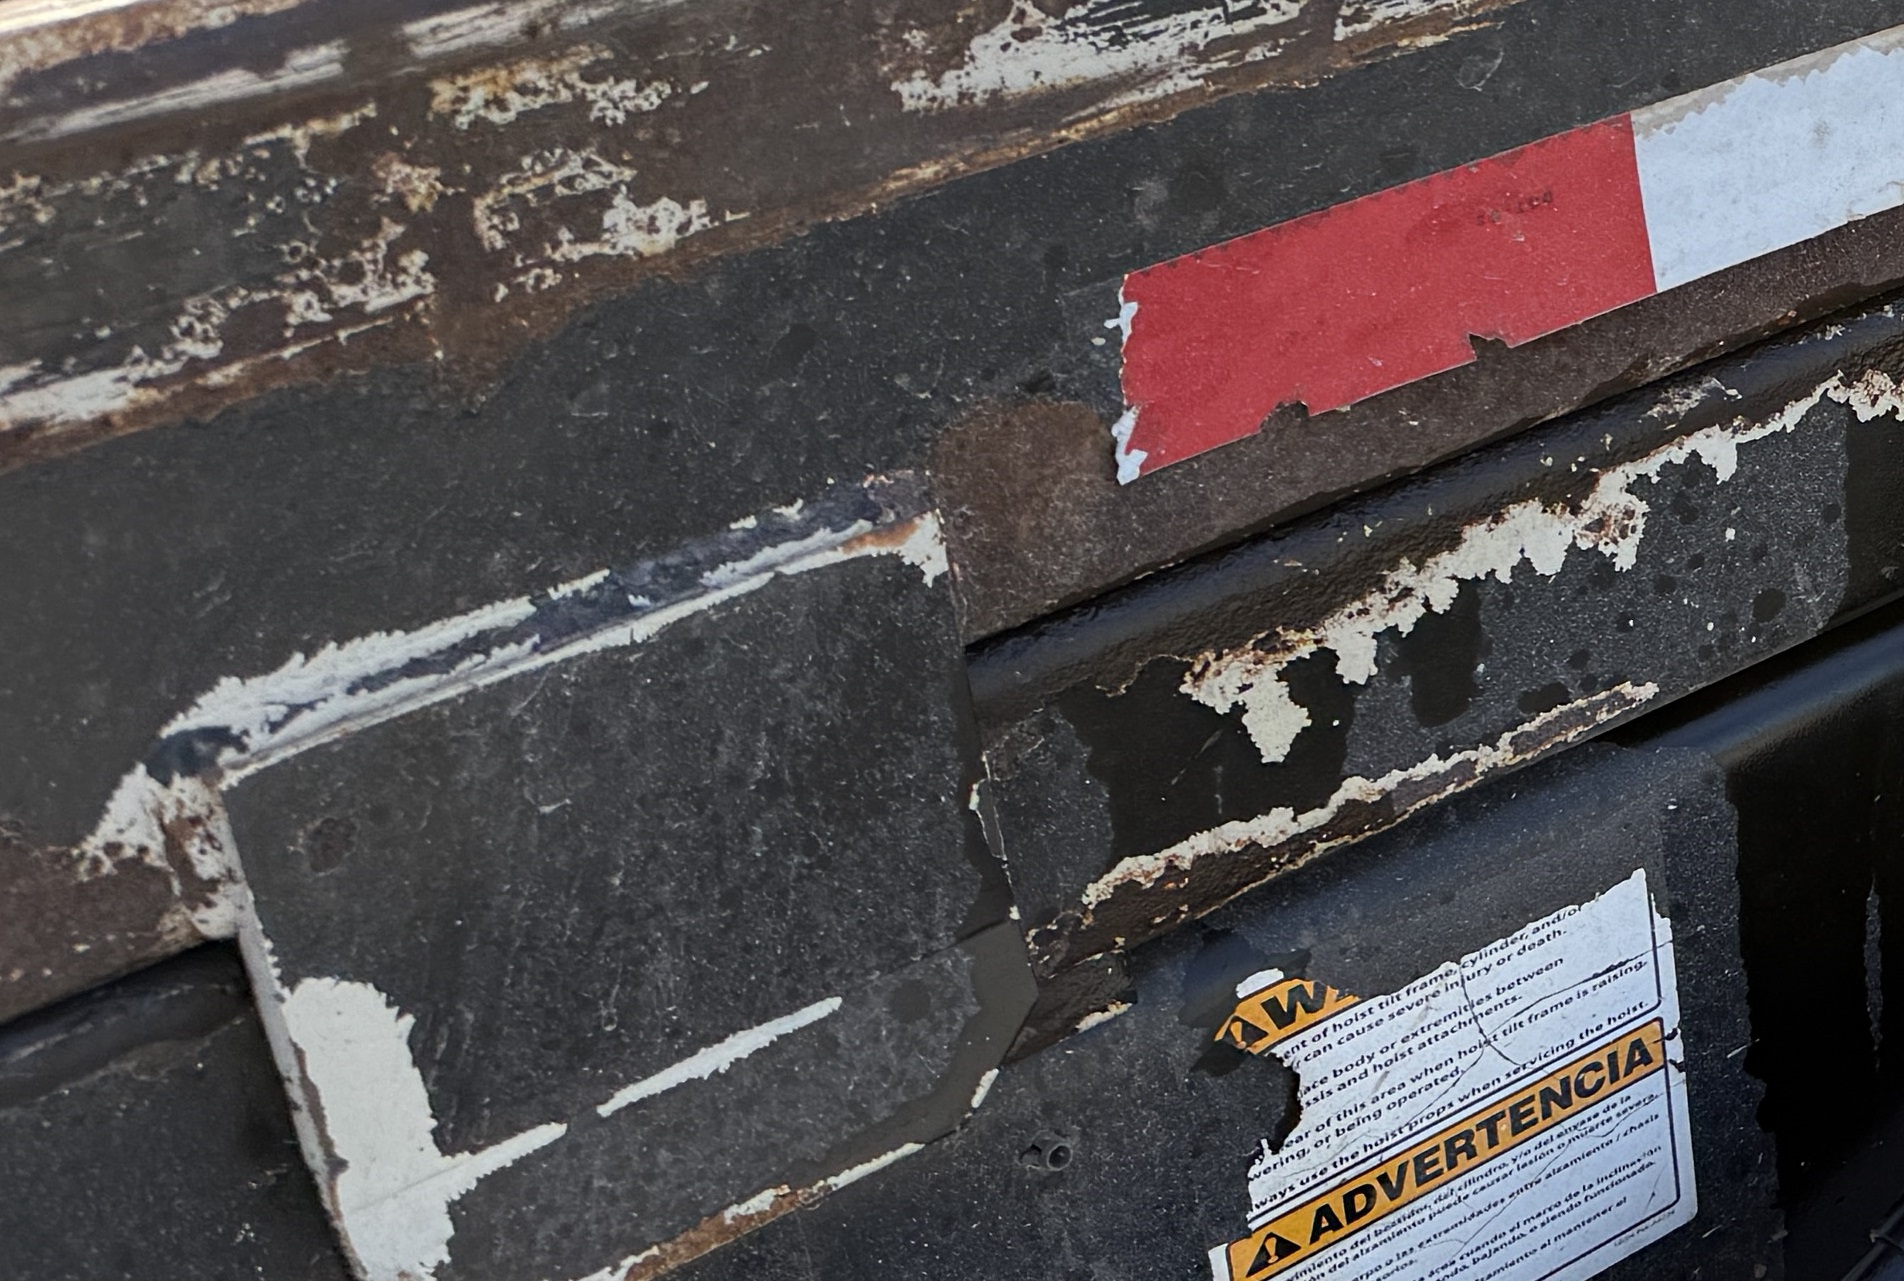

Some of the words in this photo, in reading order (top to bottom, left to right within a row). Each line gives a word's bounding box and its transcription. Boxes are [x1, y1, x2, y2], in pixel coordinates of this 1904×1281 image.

[1303, 1043, 1333, 1063] can
[1336, 1018, 1384, 1046] cause
[1388, 989, 1441, 1021] severe
[1497, 953, 1513, 967] or
[1516, 929, 1567, 956] death.
[1311, 1027, 1328, 1043] of
[1332, 1006, 1374, 1033] hoist
[1377, 988, 1402, 1010] tilt
[1332, 1051, 1375, 1079] body
[1379, 1041, 1397, 1055] or
[1400, 993, 1493, 1044] extremities
[1495, 958, 1564, 996] between
[1337, 1068, 1369, 1092] and
[1372, 1046, 1414, 1074] hoist
[1417, 995, 1523, 1051] attachments.
[1299, 1166, 1328, 1186] use
[1331, 1150, 1360, 1169] the
[1363, 1126, 1404, 1153] hoist
[1406, 1101, 1454, 1132] props
[1457, 1077, 1501, 1103] when
[1505, 1038, 1575, 1079] servicing
[1579, 1023, 1604, 1040] the
[1314, 1116, 1331, 1133] of
[1336, 1102, 1367, 1122] this
[1370, 1081, 1406, 1105] area
[1409, 1057, 1454, 1084] when
[1501, 1020, 1525, 1037] tilt
[1527, 996, 1573, 1024] frame
[1576, 989, 1589, 1000] is
[1308, 1037, 1656, 1244] ADVERTENCIA
[1313, 1134, 1330, 1149] or
[1335, 1108, 1382, 1138] being
